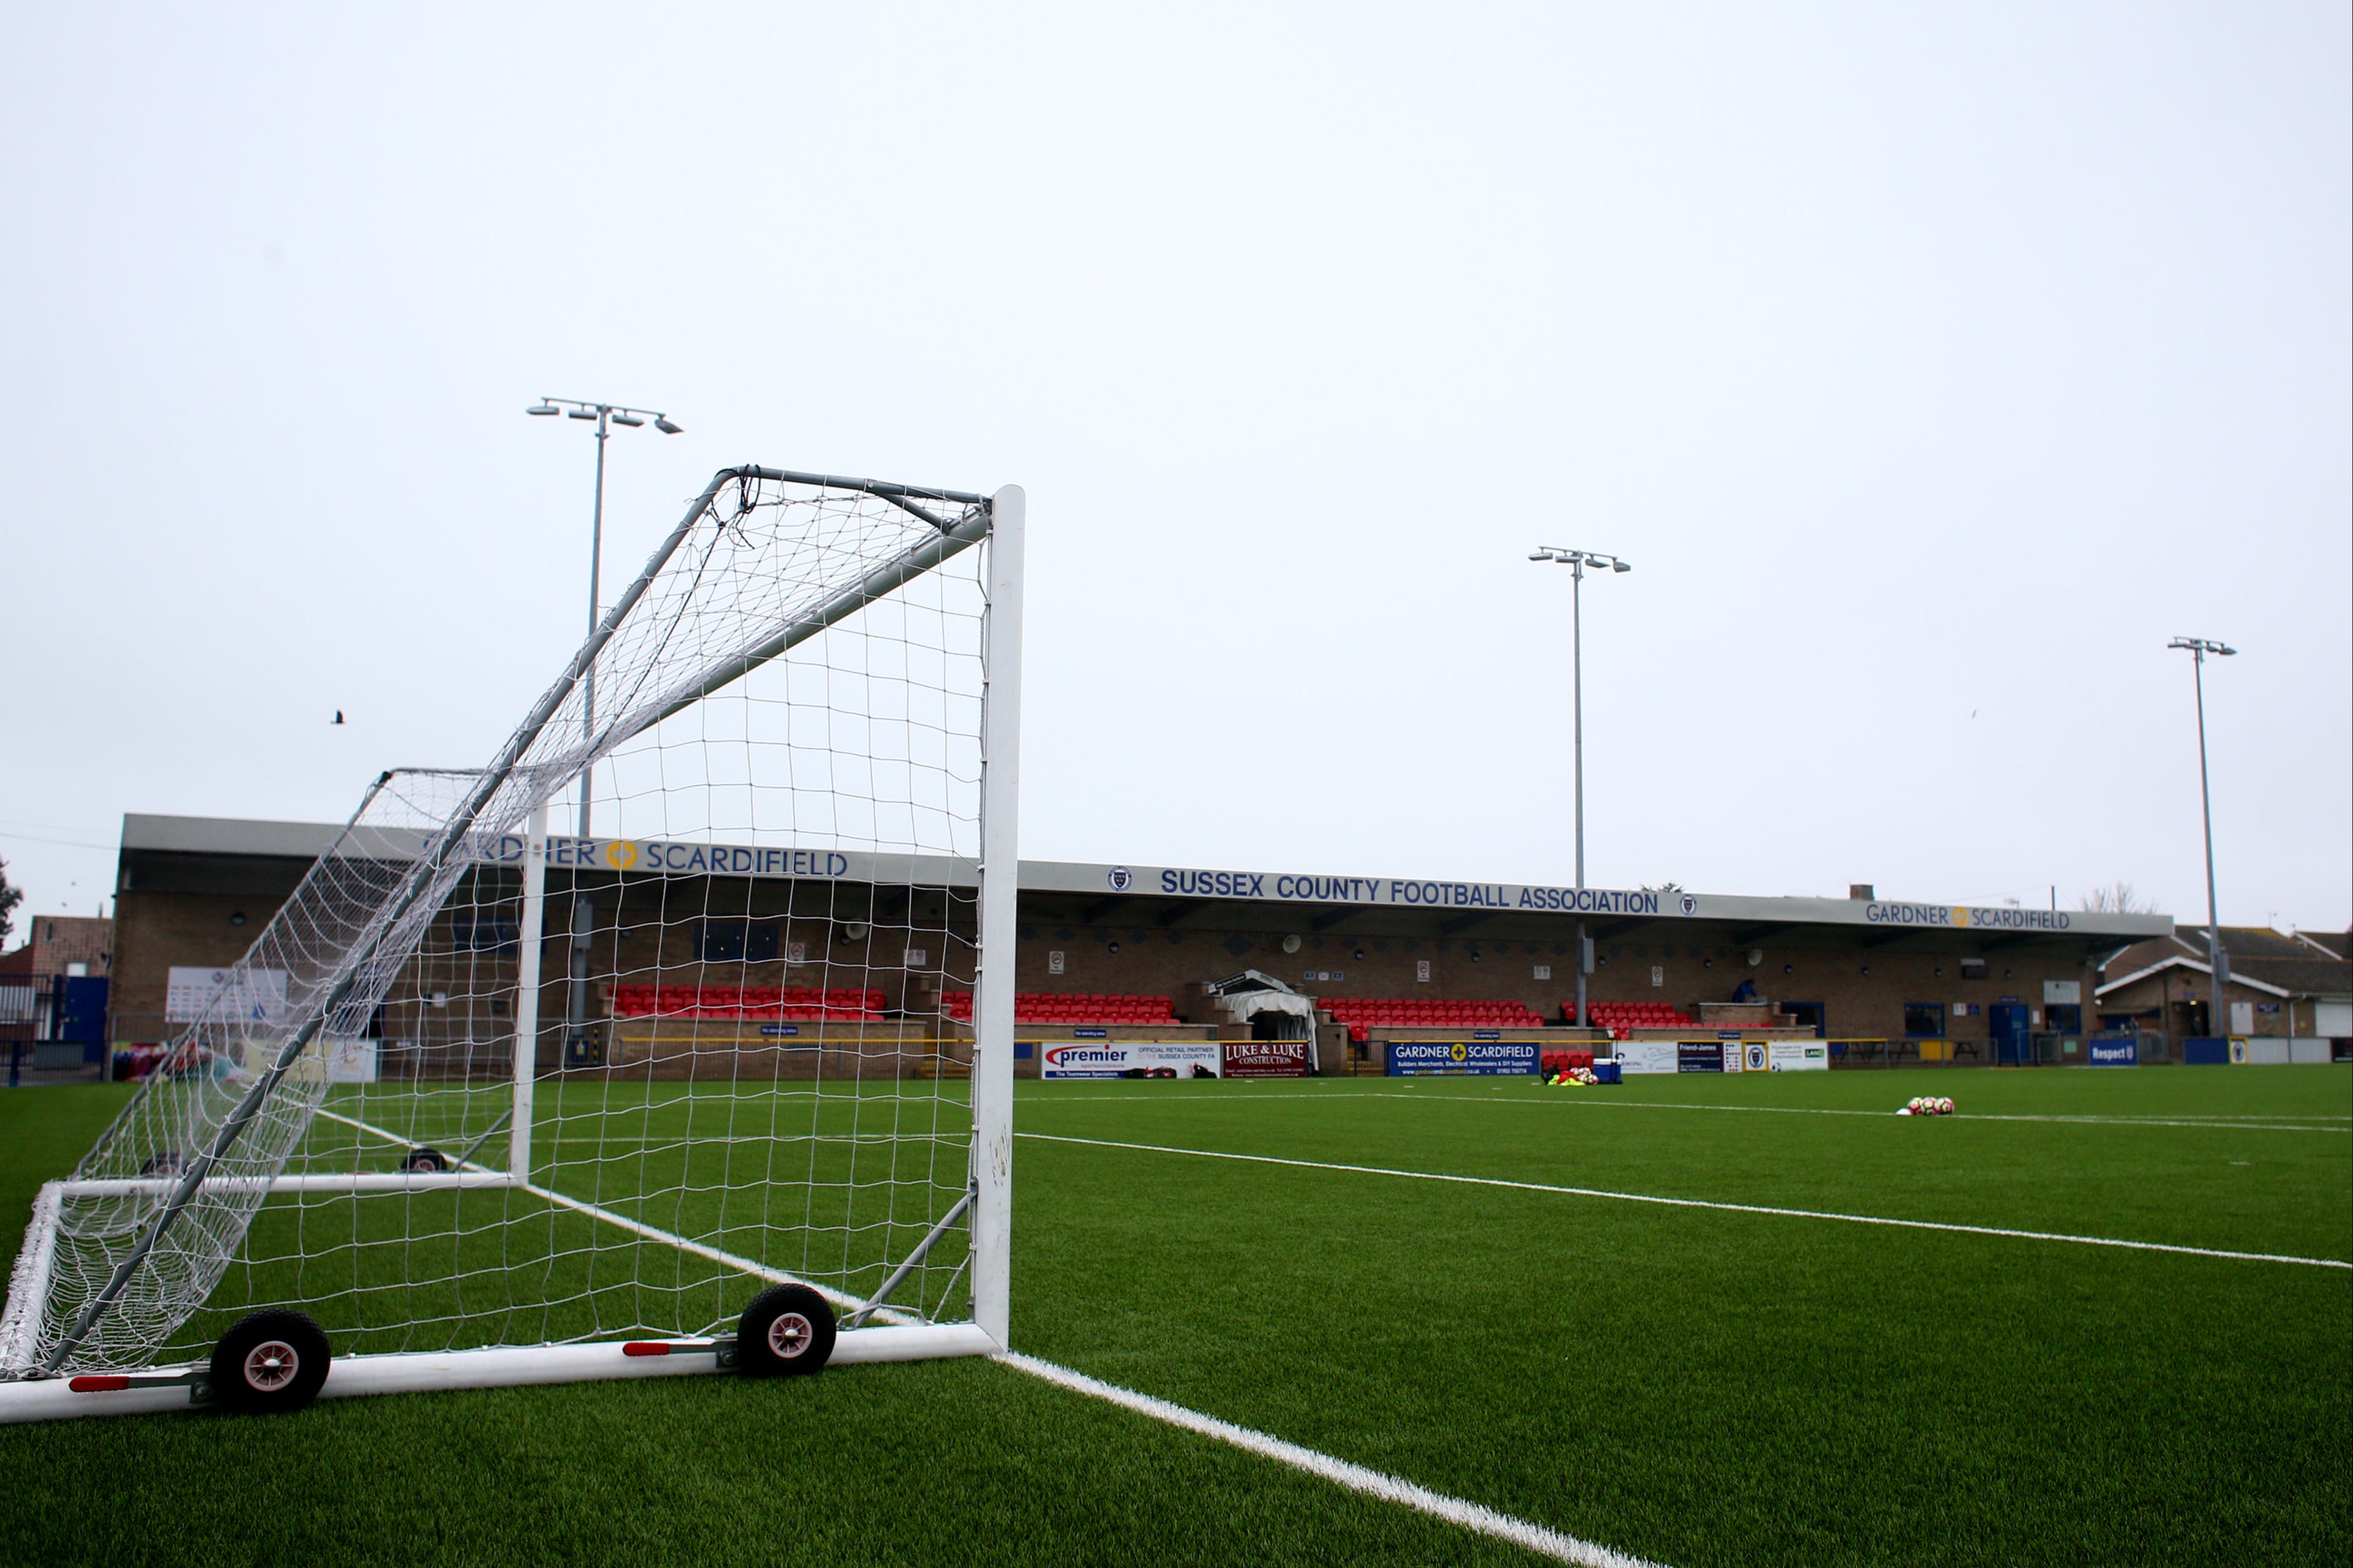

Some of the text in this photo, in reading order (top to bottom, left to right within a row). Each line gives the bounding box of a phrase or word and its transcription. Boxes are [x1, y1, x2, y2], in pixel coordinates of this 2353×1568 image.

[647, 843, 848, 877] SCARDIFIELD
[1161, 869, 1265, 897] SUSSEX
[1276, 876, 1380, 902] COUNTY
[1391, 880, 1510, 907] FOOTBALL
[1518, 887, 1658, 913] ASSOCIATION
[1866, 904, 2070, 929] GARDNER SCARDIFIELD
[1060, 1044, 1128, 1068] premier
[1225, 1044, 1304, 1061] LUKE & LUKE
[1239, 1056, 1292, 1064] CONSTRUCTION
[1395, 1046, 1534, 1057] GARDNER SCARDIFIELD
[2093, 1046, 2126, 1061] Respect
